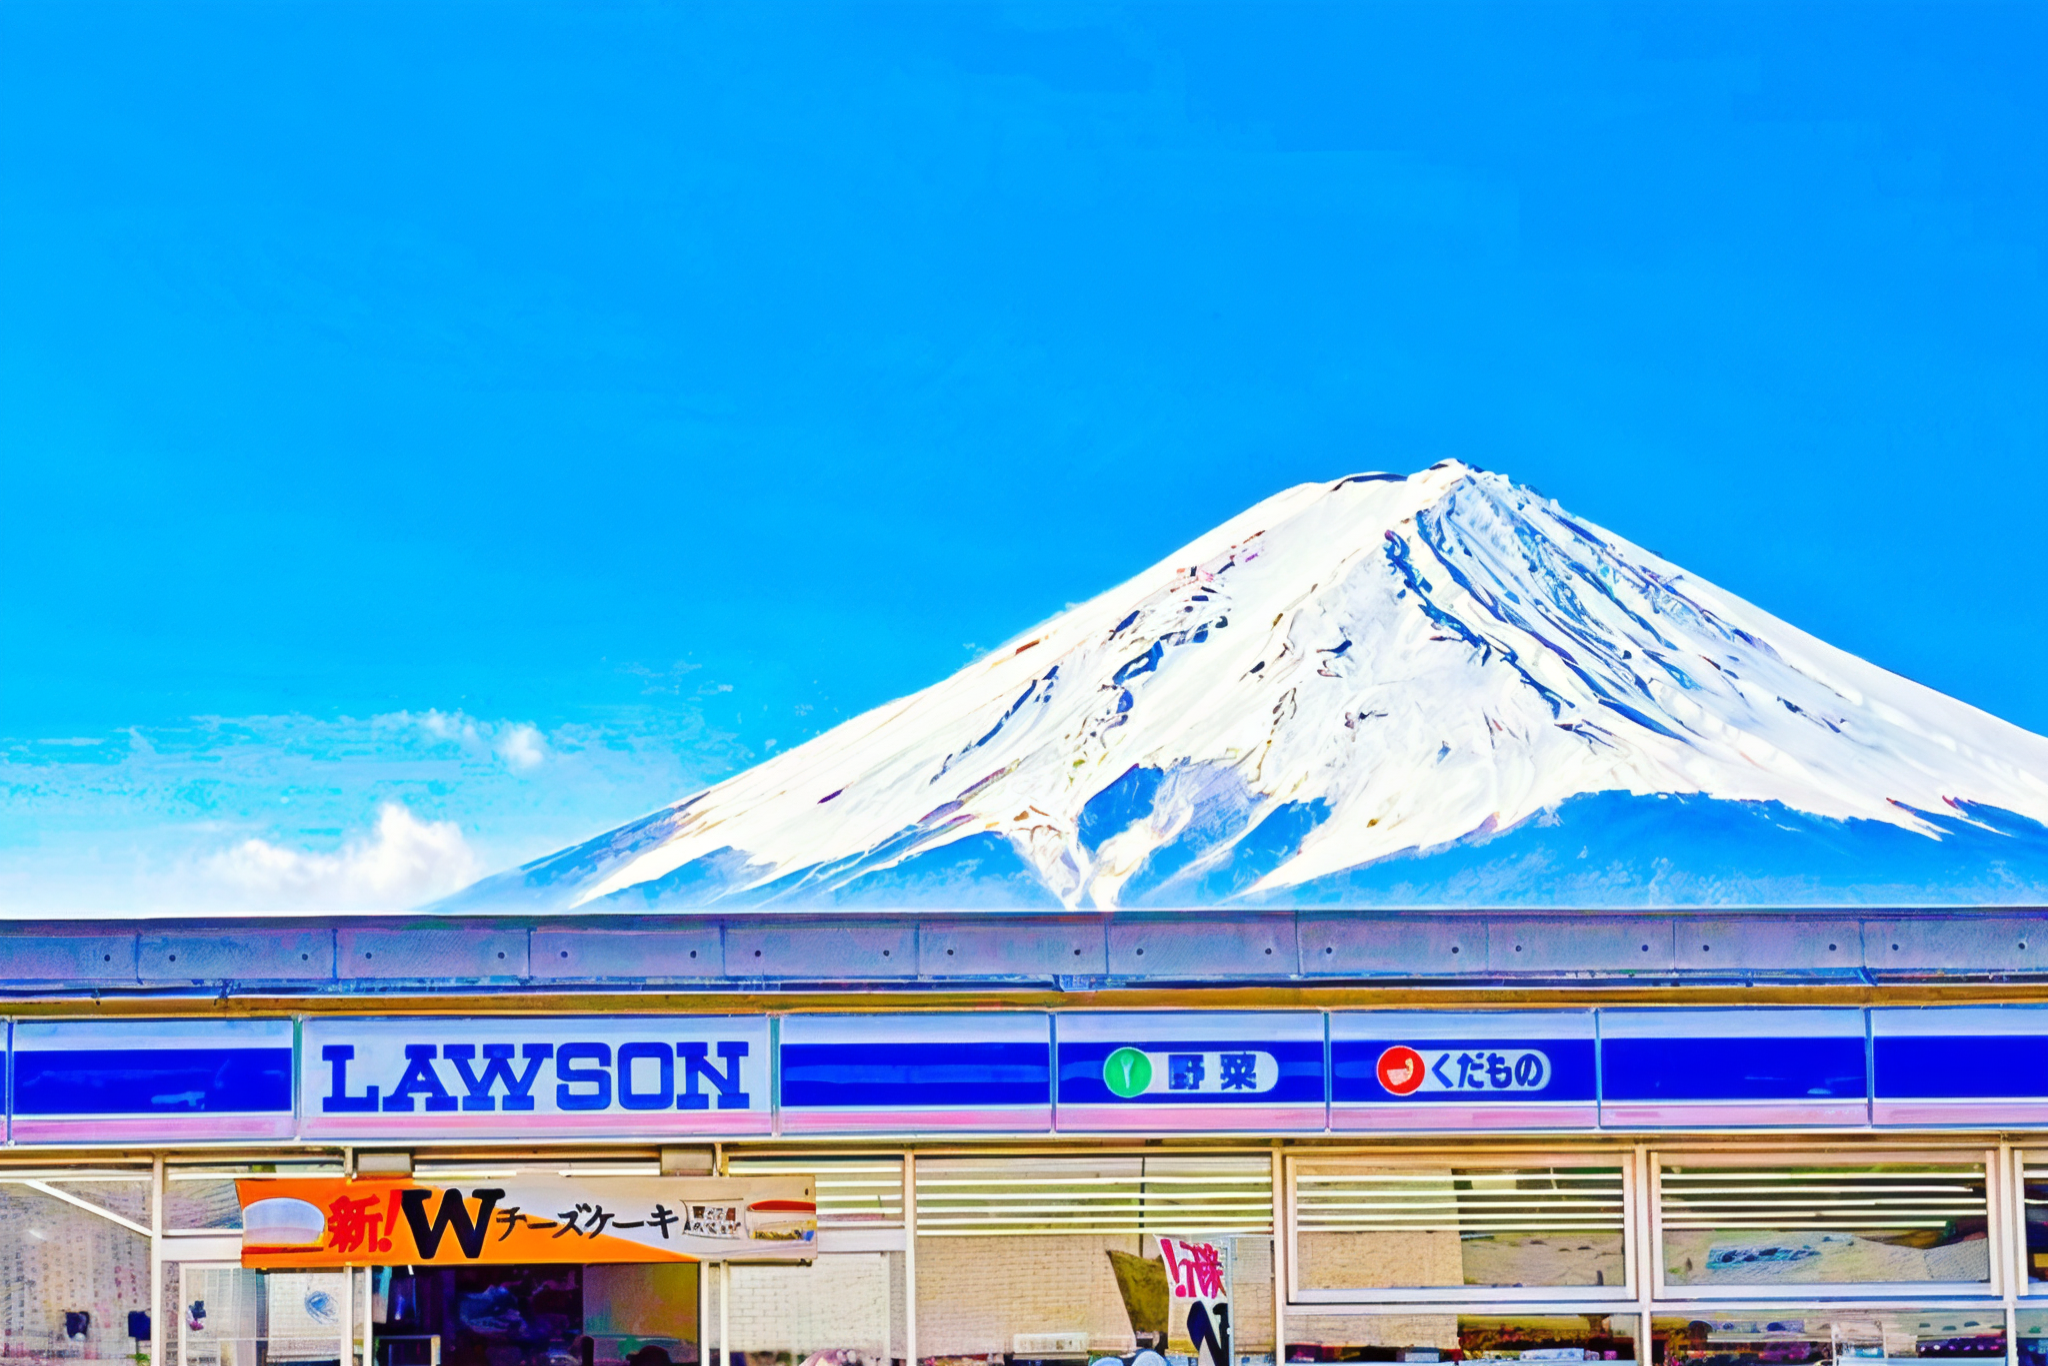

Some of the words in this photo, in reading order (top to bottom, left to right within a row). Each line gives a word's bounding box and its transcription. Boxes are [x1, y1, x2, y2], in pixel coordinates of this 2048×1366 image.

[322, 1041, 750, 1112] LAWSON
[1431, 1052, 1544, 1089] くだもの
